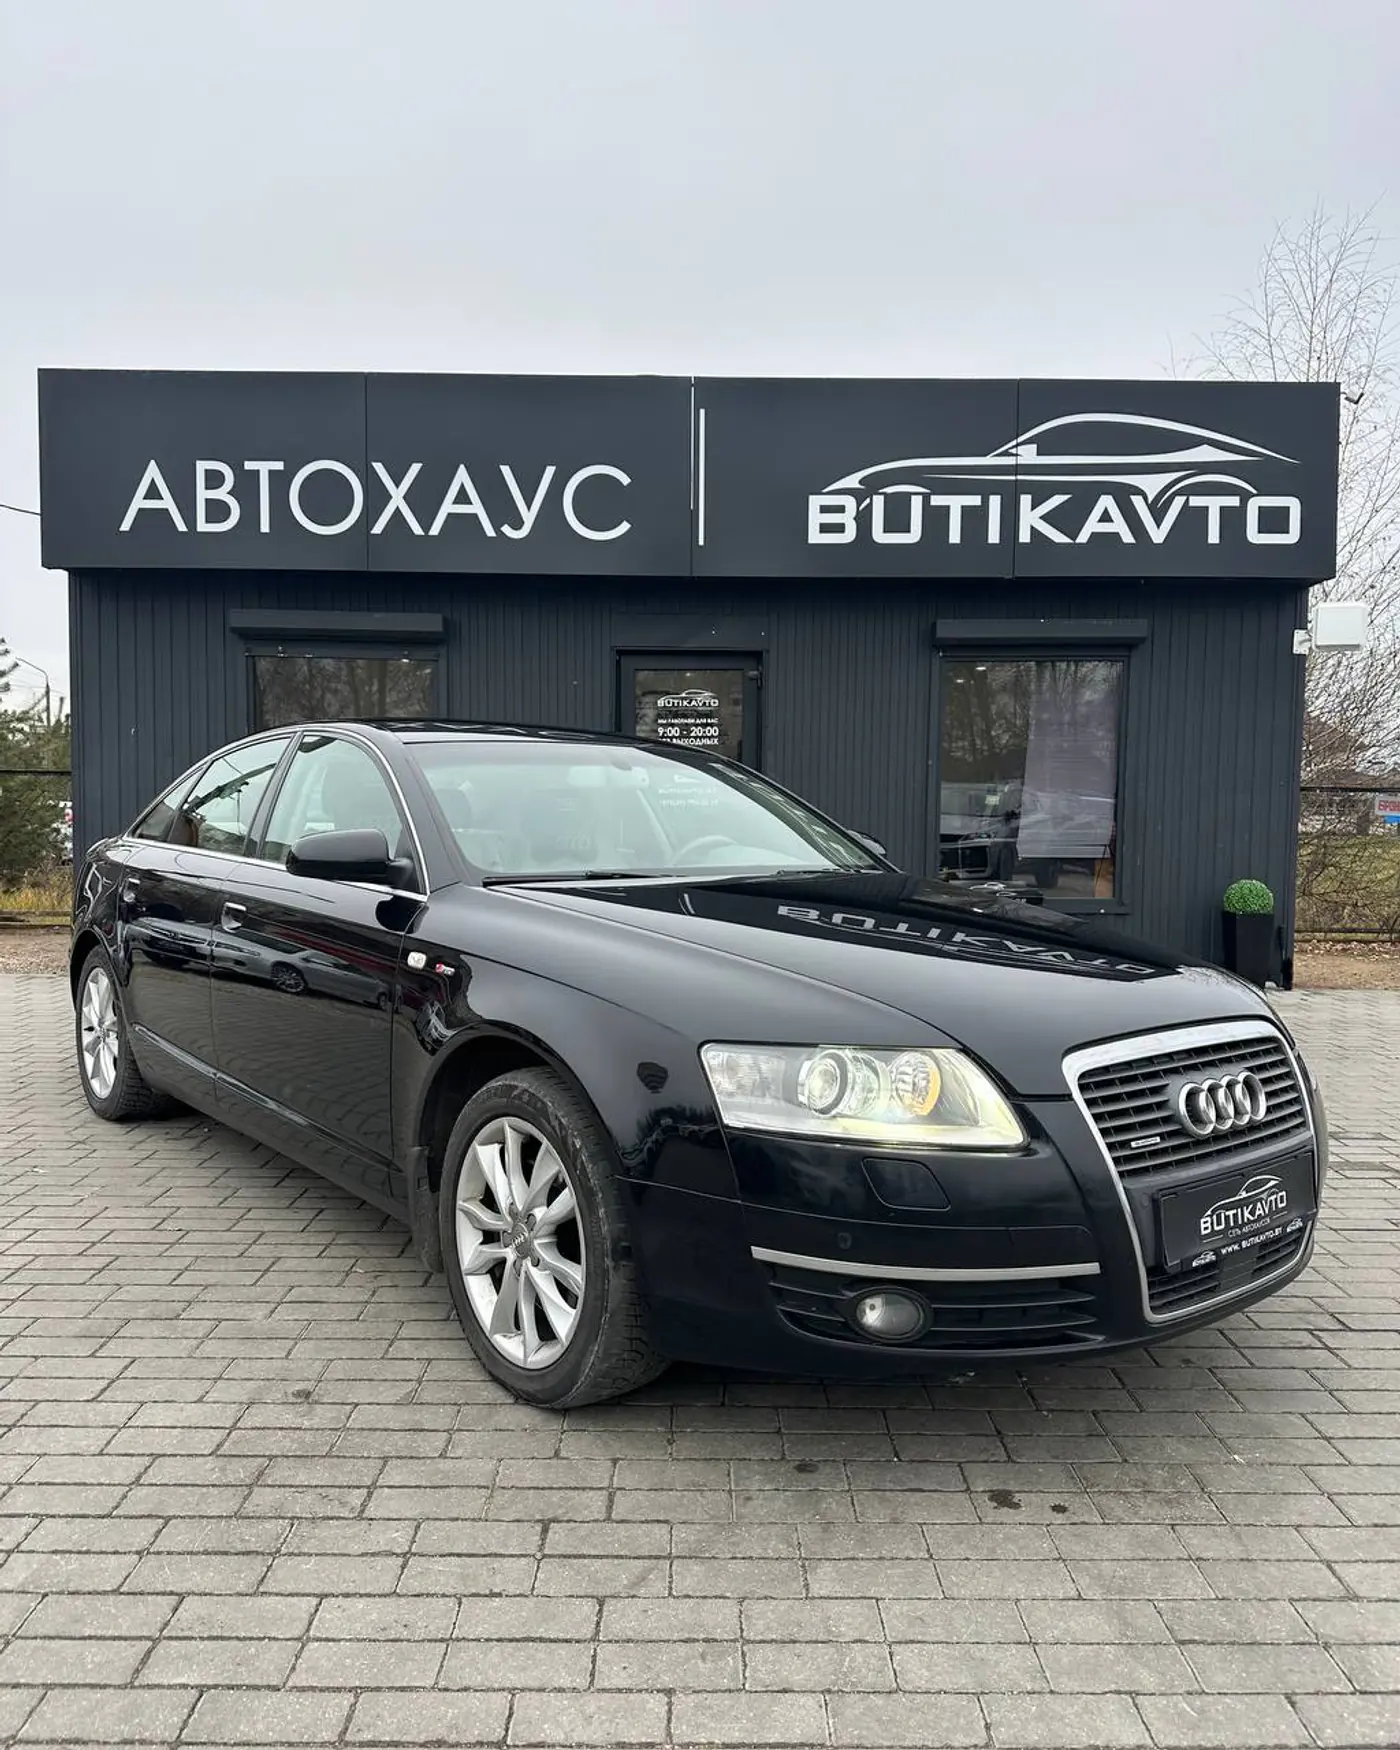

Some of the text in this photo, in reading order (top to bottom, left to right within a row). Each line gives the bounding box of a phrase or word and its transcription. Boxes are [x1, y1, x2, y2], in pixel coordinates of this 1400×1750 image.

[119, 458, 633, 542] АВТОХАУС
[808, 494, 1301, 545] BUTIKAVTO
[657, 699, 719, 707] BUTIKAVTO
[657, 726, 680, 737] 9:00
[690, 726, 719, 736] 20:00
[1201, 1191, 1287, 1235] BUTIKAVTO
